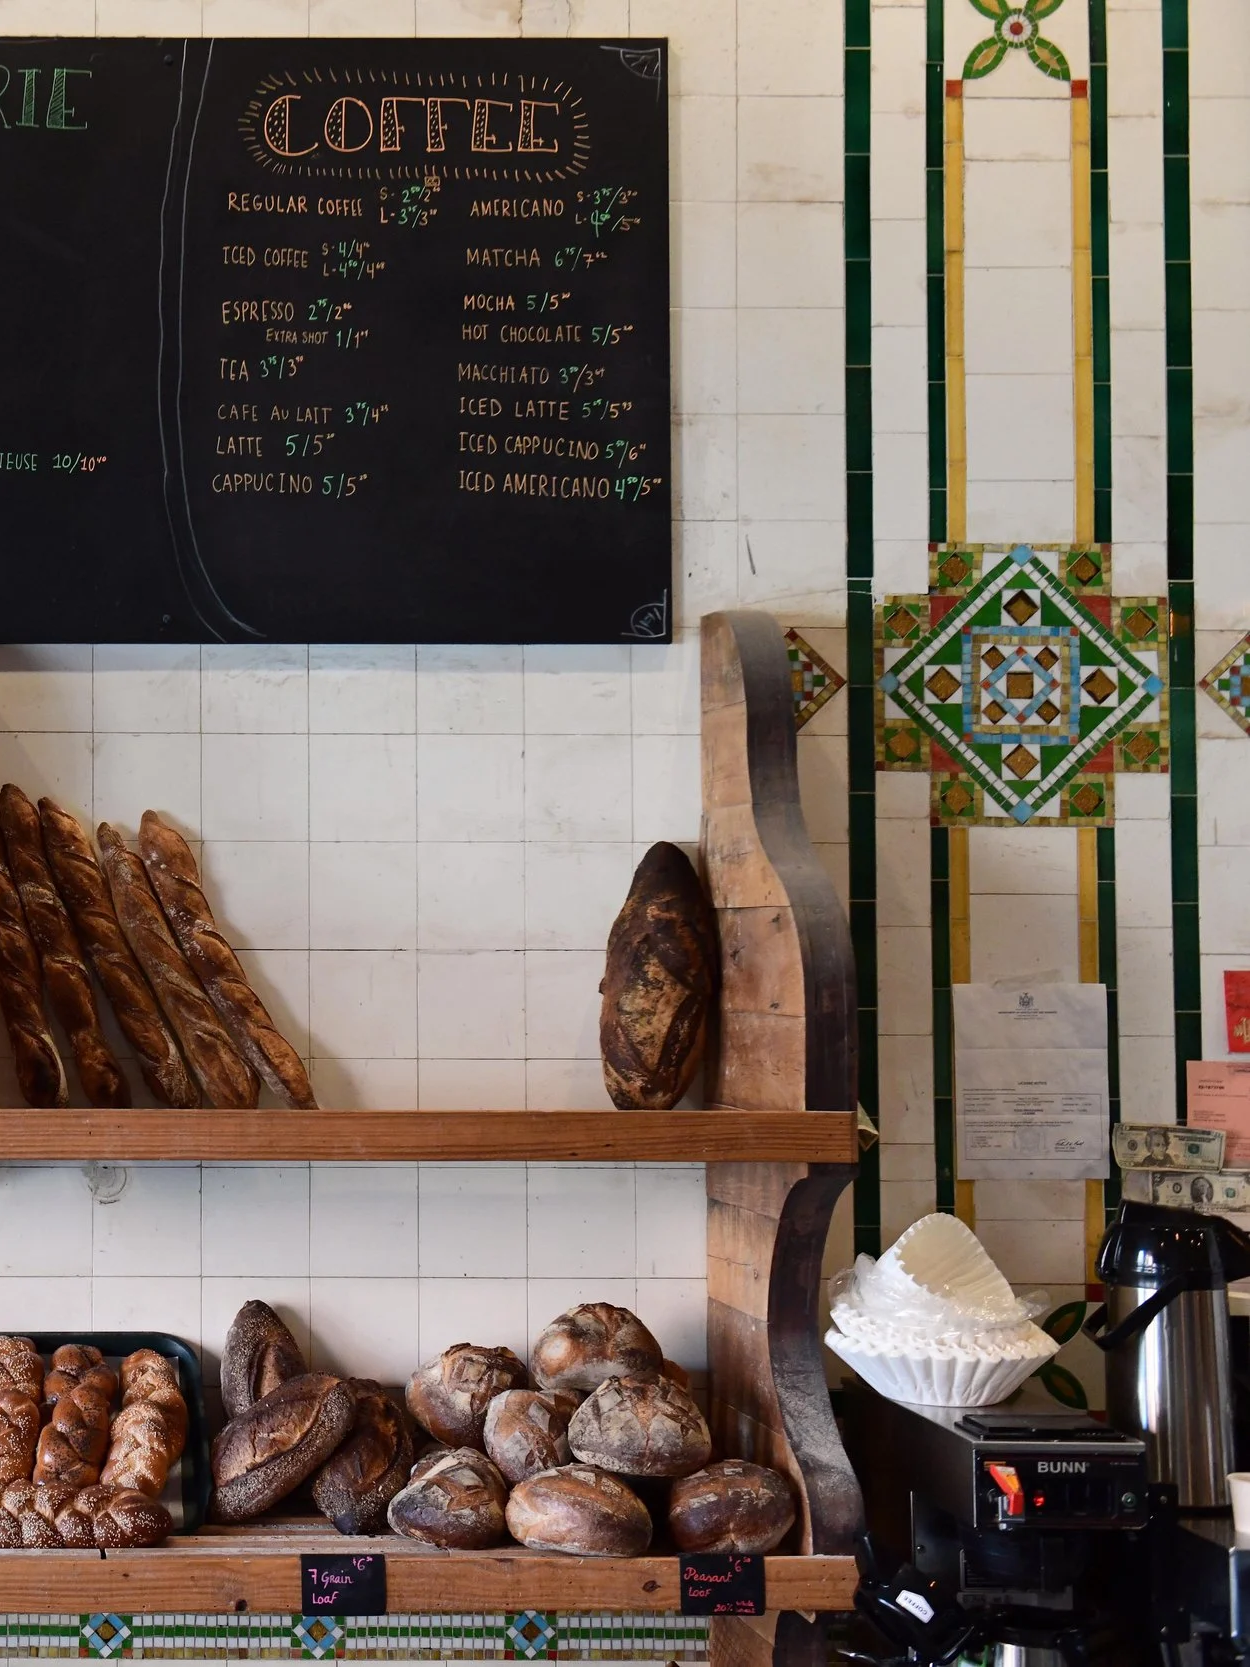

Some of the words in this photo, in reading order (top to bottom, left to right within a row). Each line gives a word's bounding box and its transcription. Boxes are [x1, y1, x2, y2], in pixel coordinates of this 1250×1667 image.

[264, 95, 559, 156] COFFEE
[229, 192, 307, 213] REGULAR
[318, 197, 362, 216] COFFEE
[470, 198, 563, 217] AMERICANO
[223, 246, 255, 266] ICED
[264, 248, 308, 268] COFFEE
[467, 248, 540, 267] MATCHA
[222, 300, 294, 324] ESPRESSO
[464, 294, 515, 311] MOCHA
[266, 328, 297, 344] EXTRA
[302, 331, 328, 344] SHOT
[462, 324, 488, 340] HOT
[501, 325, 581, 342] CHOCOLATE
[220, 358, 248, 381] TEA
[458, 363, 549, 384] MACCHIATO
[218, 404, 257, 421] CAFE
[271, 405, 289, 420] AU
[297, 407, 332, 424] LAIT
[460, 397, 502, 416] ICED
[515, 400, 569, 420] LATTE
[217, 436, 262, 457] LATTE
[459, 432, 497, 454] ICED
[505, 436, 599, 460] CAPPUCINO
[212, 473, 312, 493] CAPPUCINO
[460, 470, 495, 492] ICED
[503, 473, 609, 498] AMERICANO
[1037, 1461, 1086, 1474] BUNN
[307, 1568, 318, 1585] 7
[684, 1567, 732, 1582] Peasant
[904, 1596, 928, 1616] COFFEE
